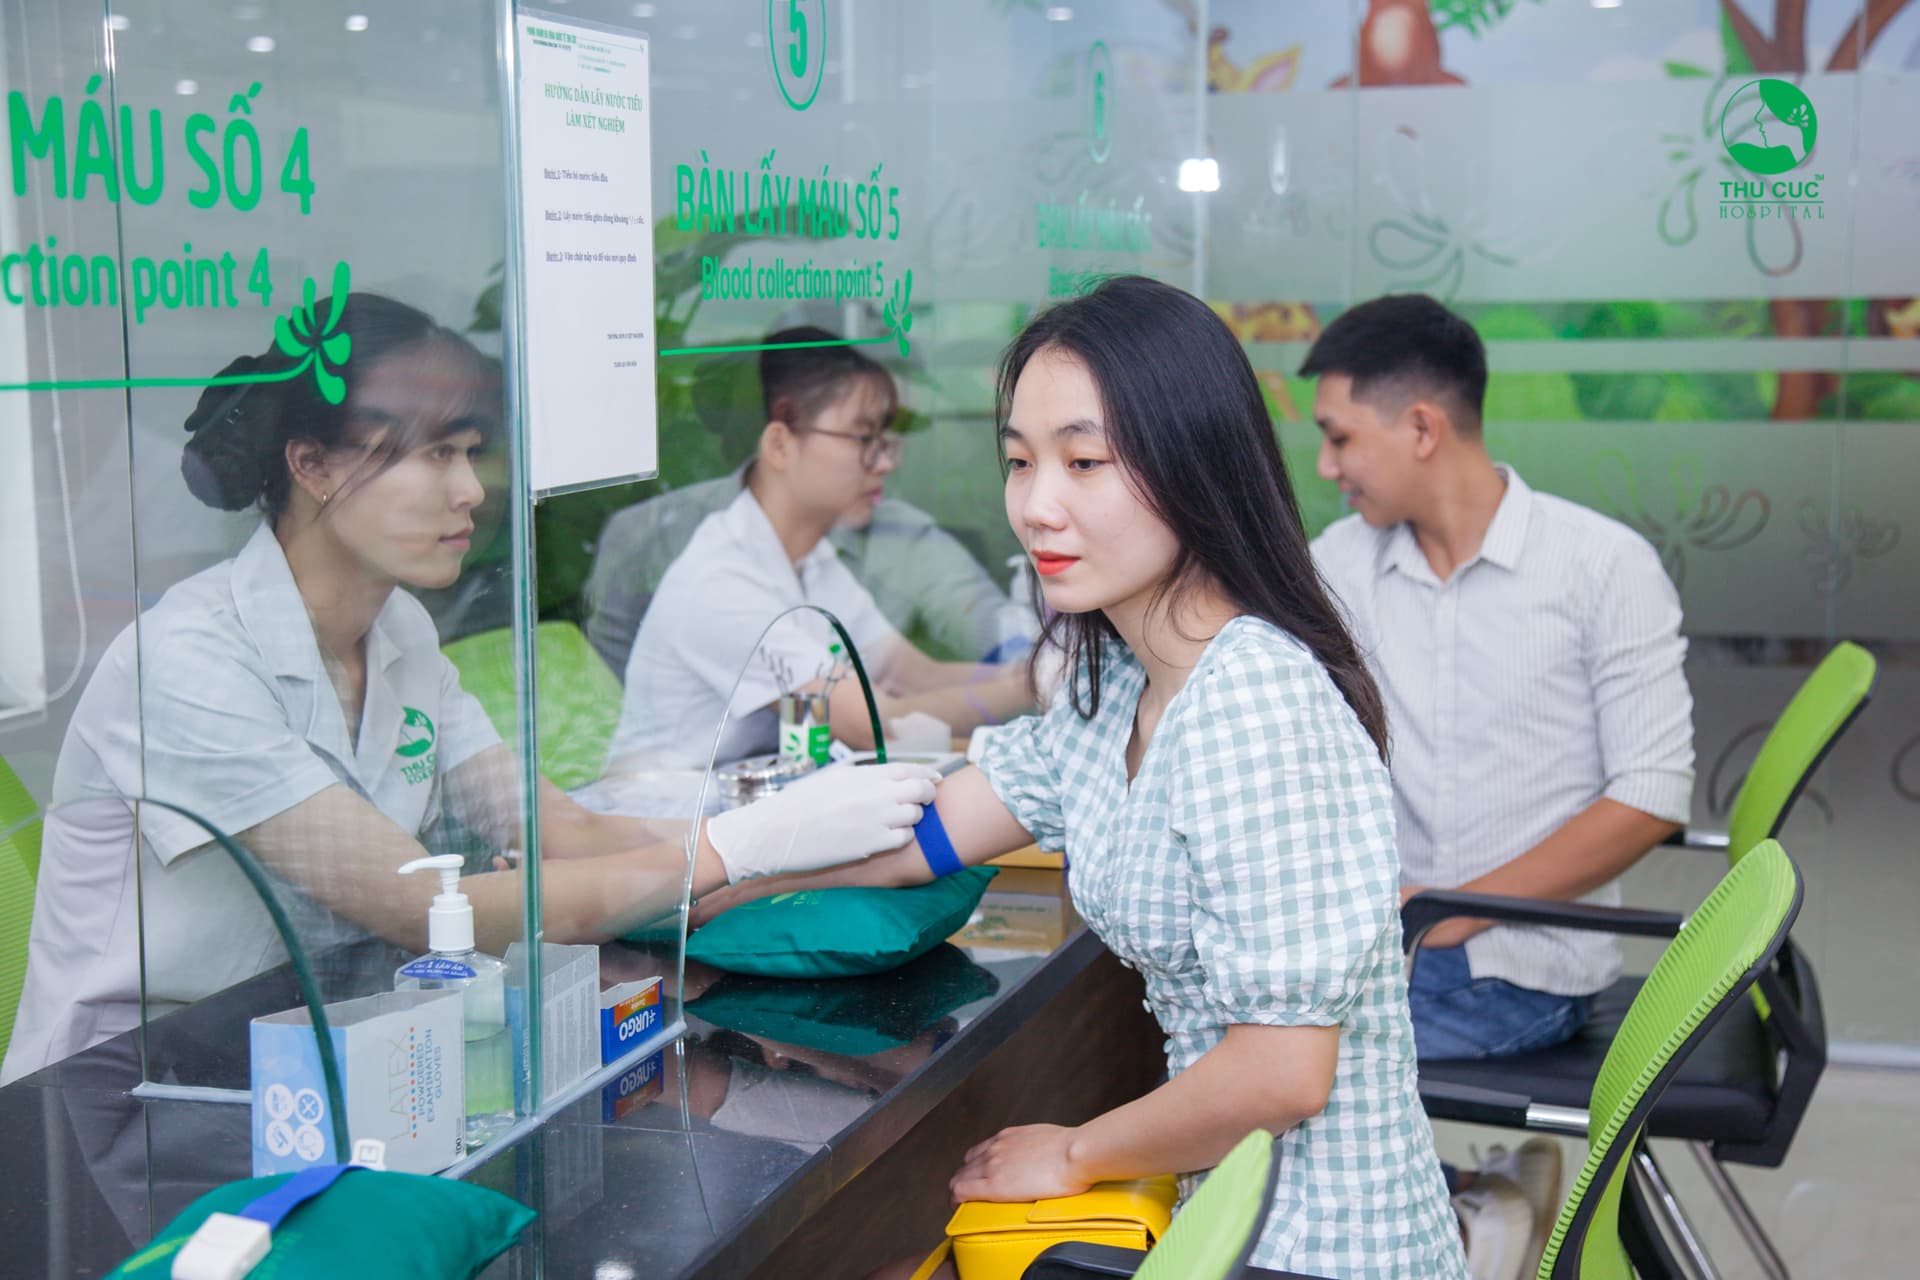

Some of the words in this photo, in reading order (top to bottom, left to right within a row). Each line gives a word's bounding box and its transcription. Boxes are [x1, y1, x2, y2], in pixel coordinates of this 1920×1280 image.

[788, 0, 807, 78] 5
[7, 74, 164, 206] MÁU
[183, 81, 263, 212] SỐ
[279, 127, 316, 215] 4
[675, 149, 734, 235] BÀN
[743, 149, 790, 237] LẤY
[797, 164, 849, 239] MÁU
[854, 163, 883, 241] SỐ
[887, 186, 899, 241] 5
[0, 235, 118, 308] ction
[131, 241, 239, 325] point
[247, 247, 273, 308] 4
[701, 255, 753, 301] Blood
[756, 257, 833, 300] collection
[835, 258, 873, 309] point
[874, 260, 884, 298] 5
[618, 1010, 650, 1042] URGO
[416, 1042, 426, 1117] POWDERED
[424, 1028, 435, 1123] EXAMINATION
[433, 1045, 442, 1099] GLOVES
